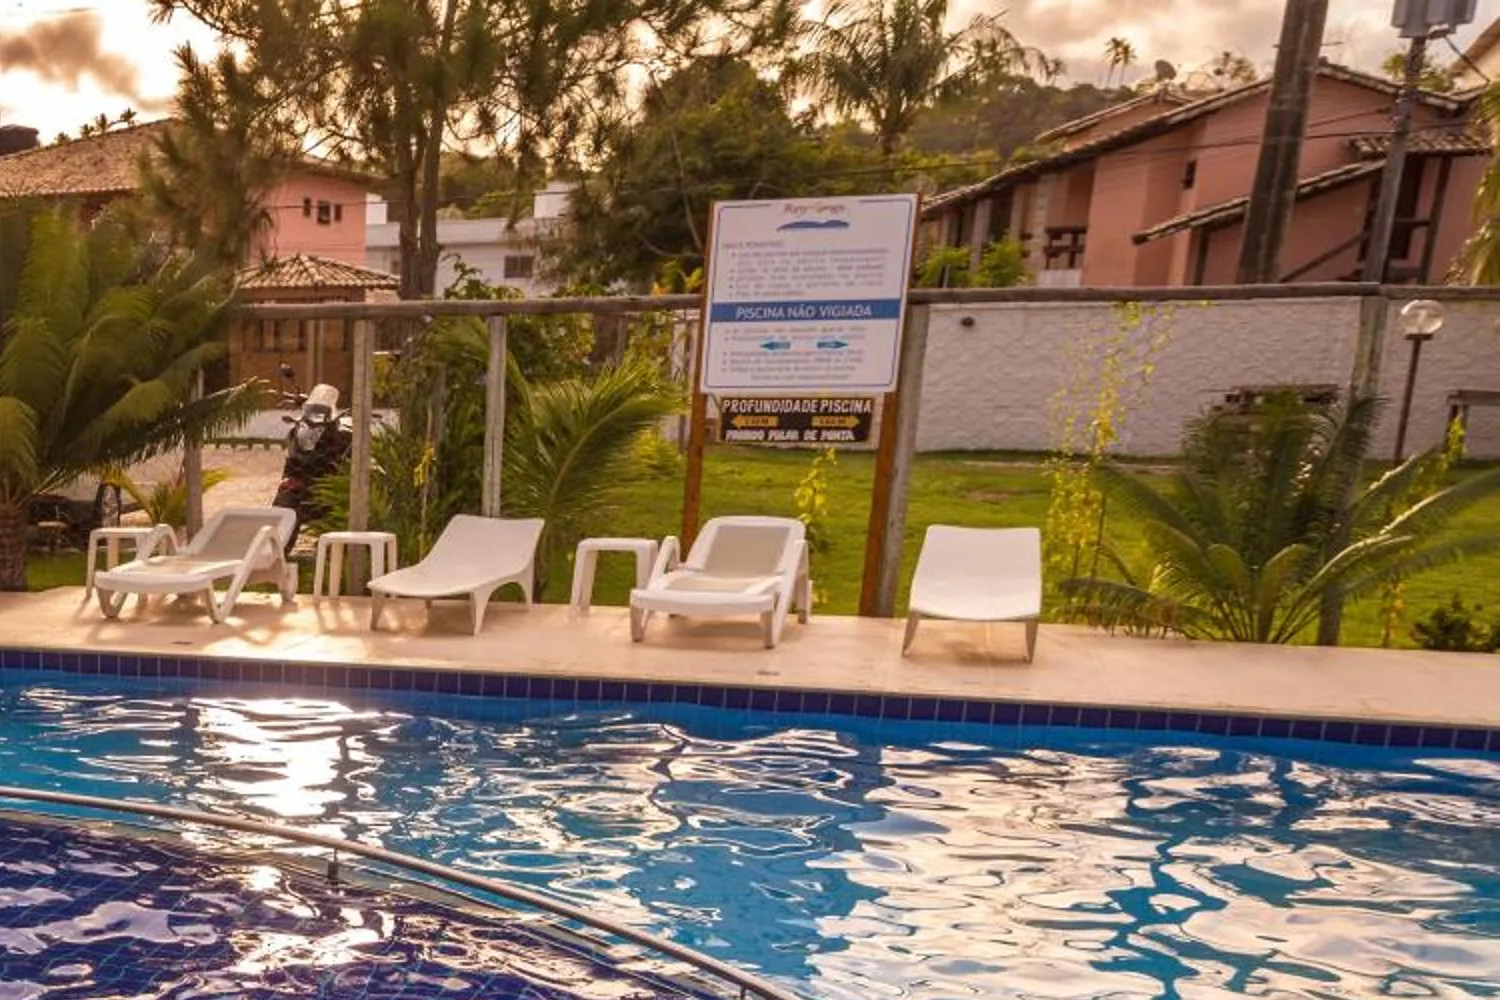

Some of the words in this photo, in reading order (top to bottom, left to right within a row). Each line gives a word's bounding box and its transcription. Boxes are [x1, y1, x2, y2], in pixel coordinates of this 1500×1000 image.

[735, 306, 785, 319] PISCINA
[787, 304, 816, 318] NÃO
[819, 304, 872, 317] VIGIADA
[722, 399, 817, 413] PROFUNDIDADE
[819, 399, 871, 413] PISCINA
